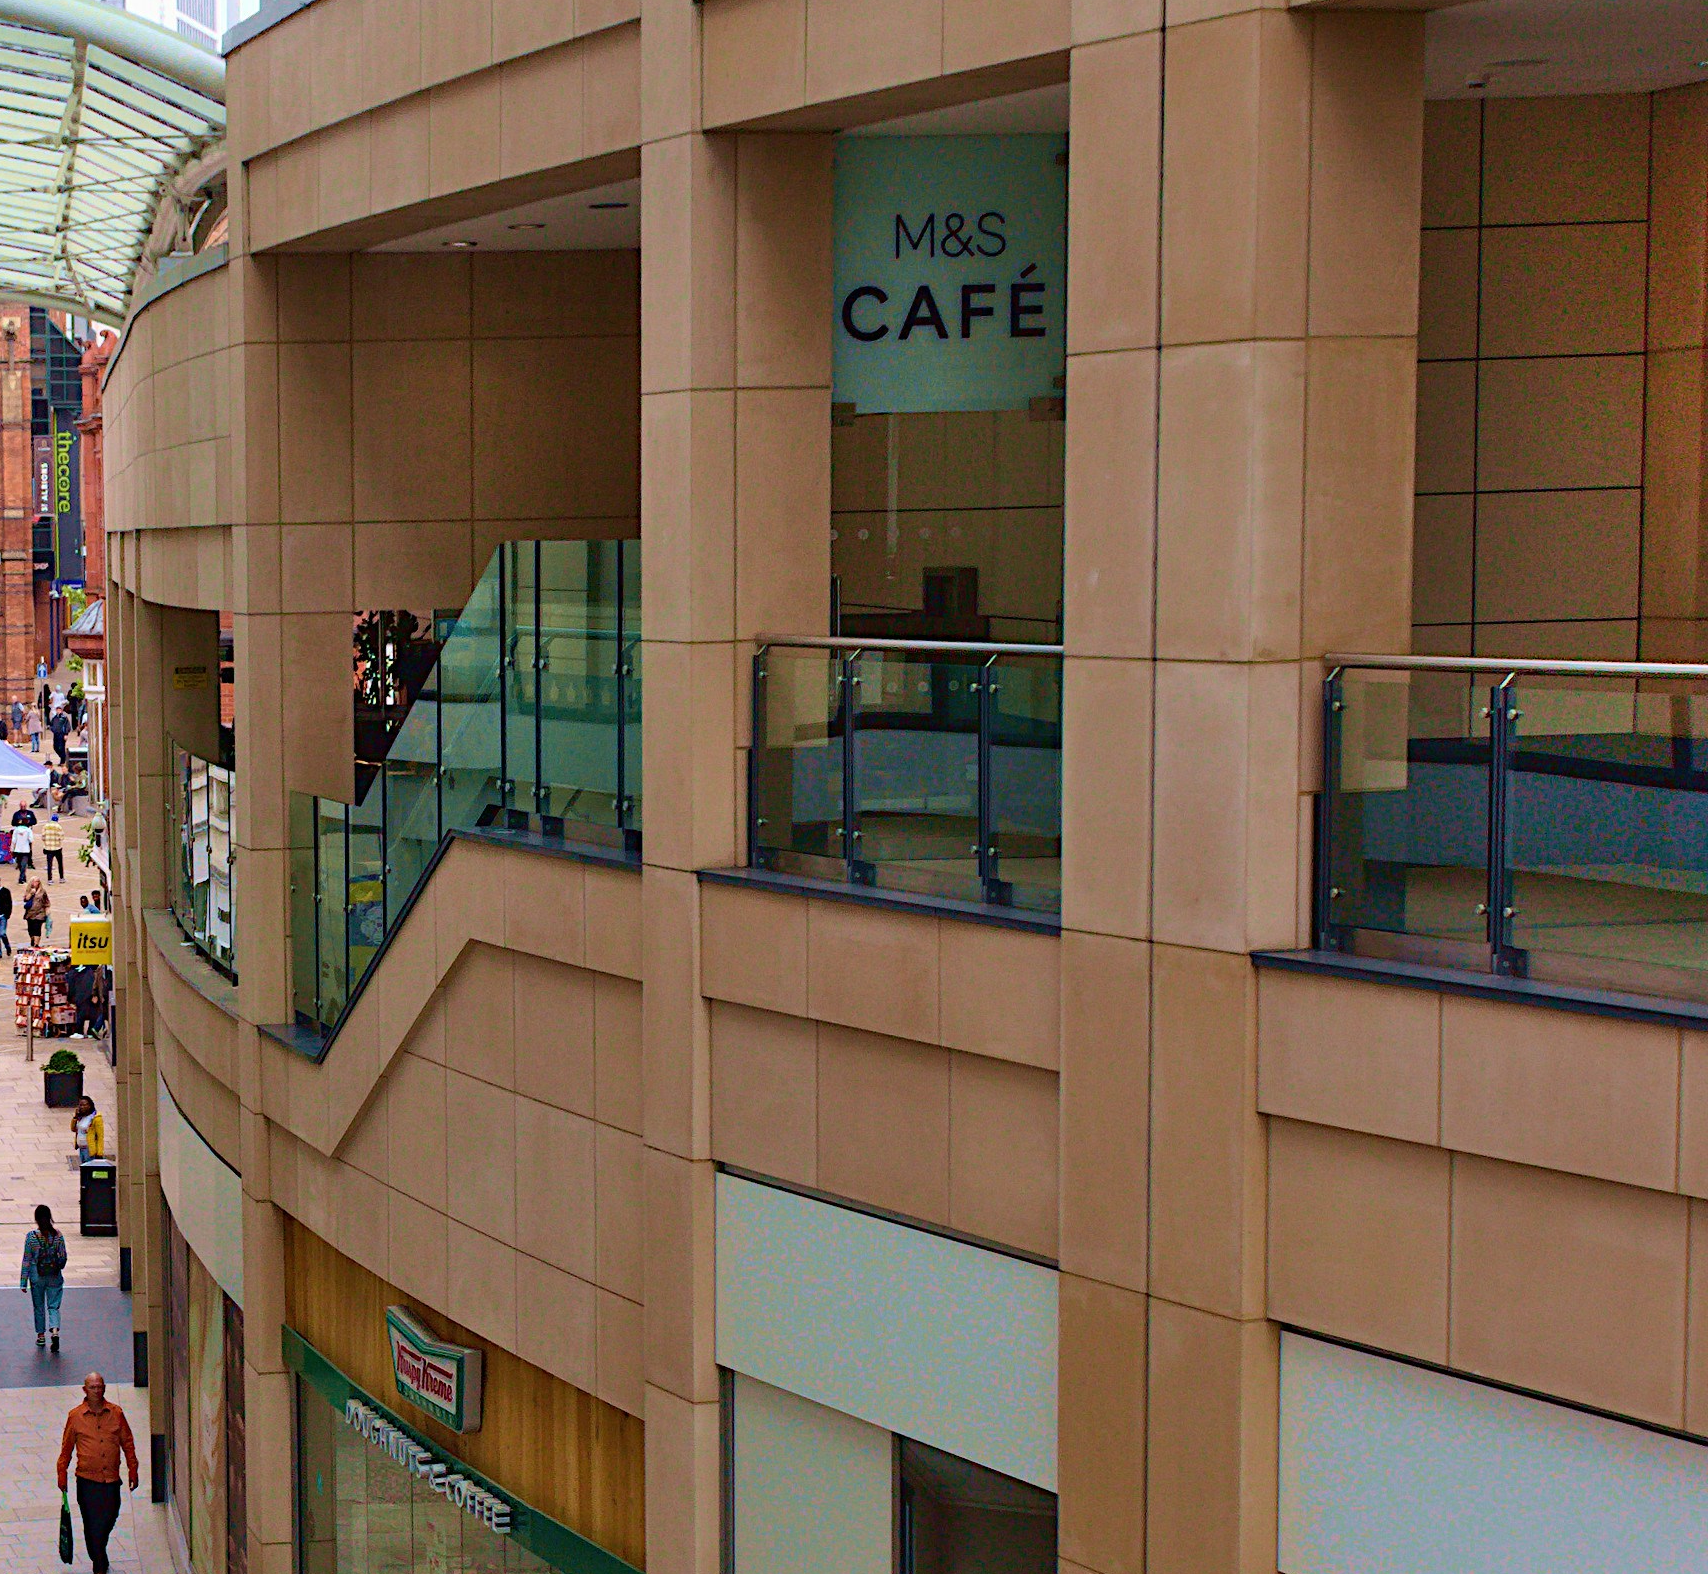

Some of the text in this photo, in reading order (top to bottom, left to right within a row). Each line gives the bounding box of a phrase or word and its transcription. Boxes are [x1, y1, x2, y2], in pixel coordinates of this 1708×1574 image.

[894, 211, 1007, 260] M&S
[841, 262, 1047, 343] CAFÉ
[58, 430, 73, 514] thecore
[77, 932, 109, 949] itsu
[422, 1357, 454, 1403] Kreme
[446, 1474, 511, 1534] COFFEE
